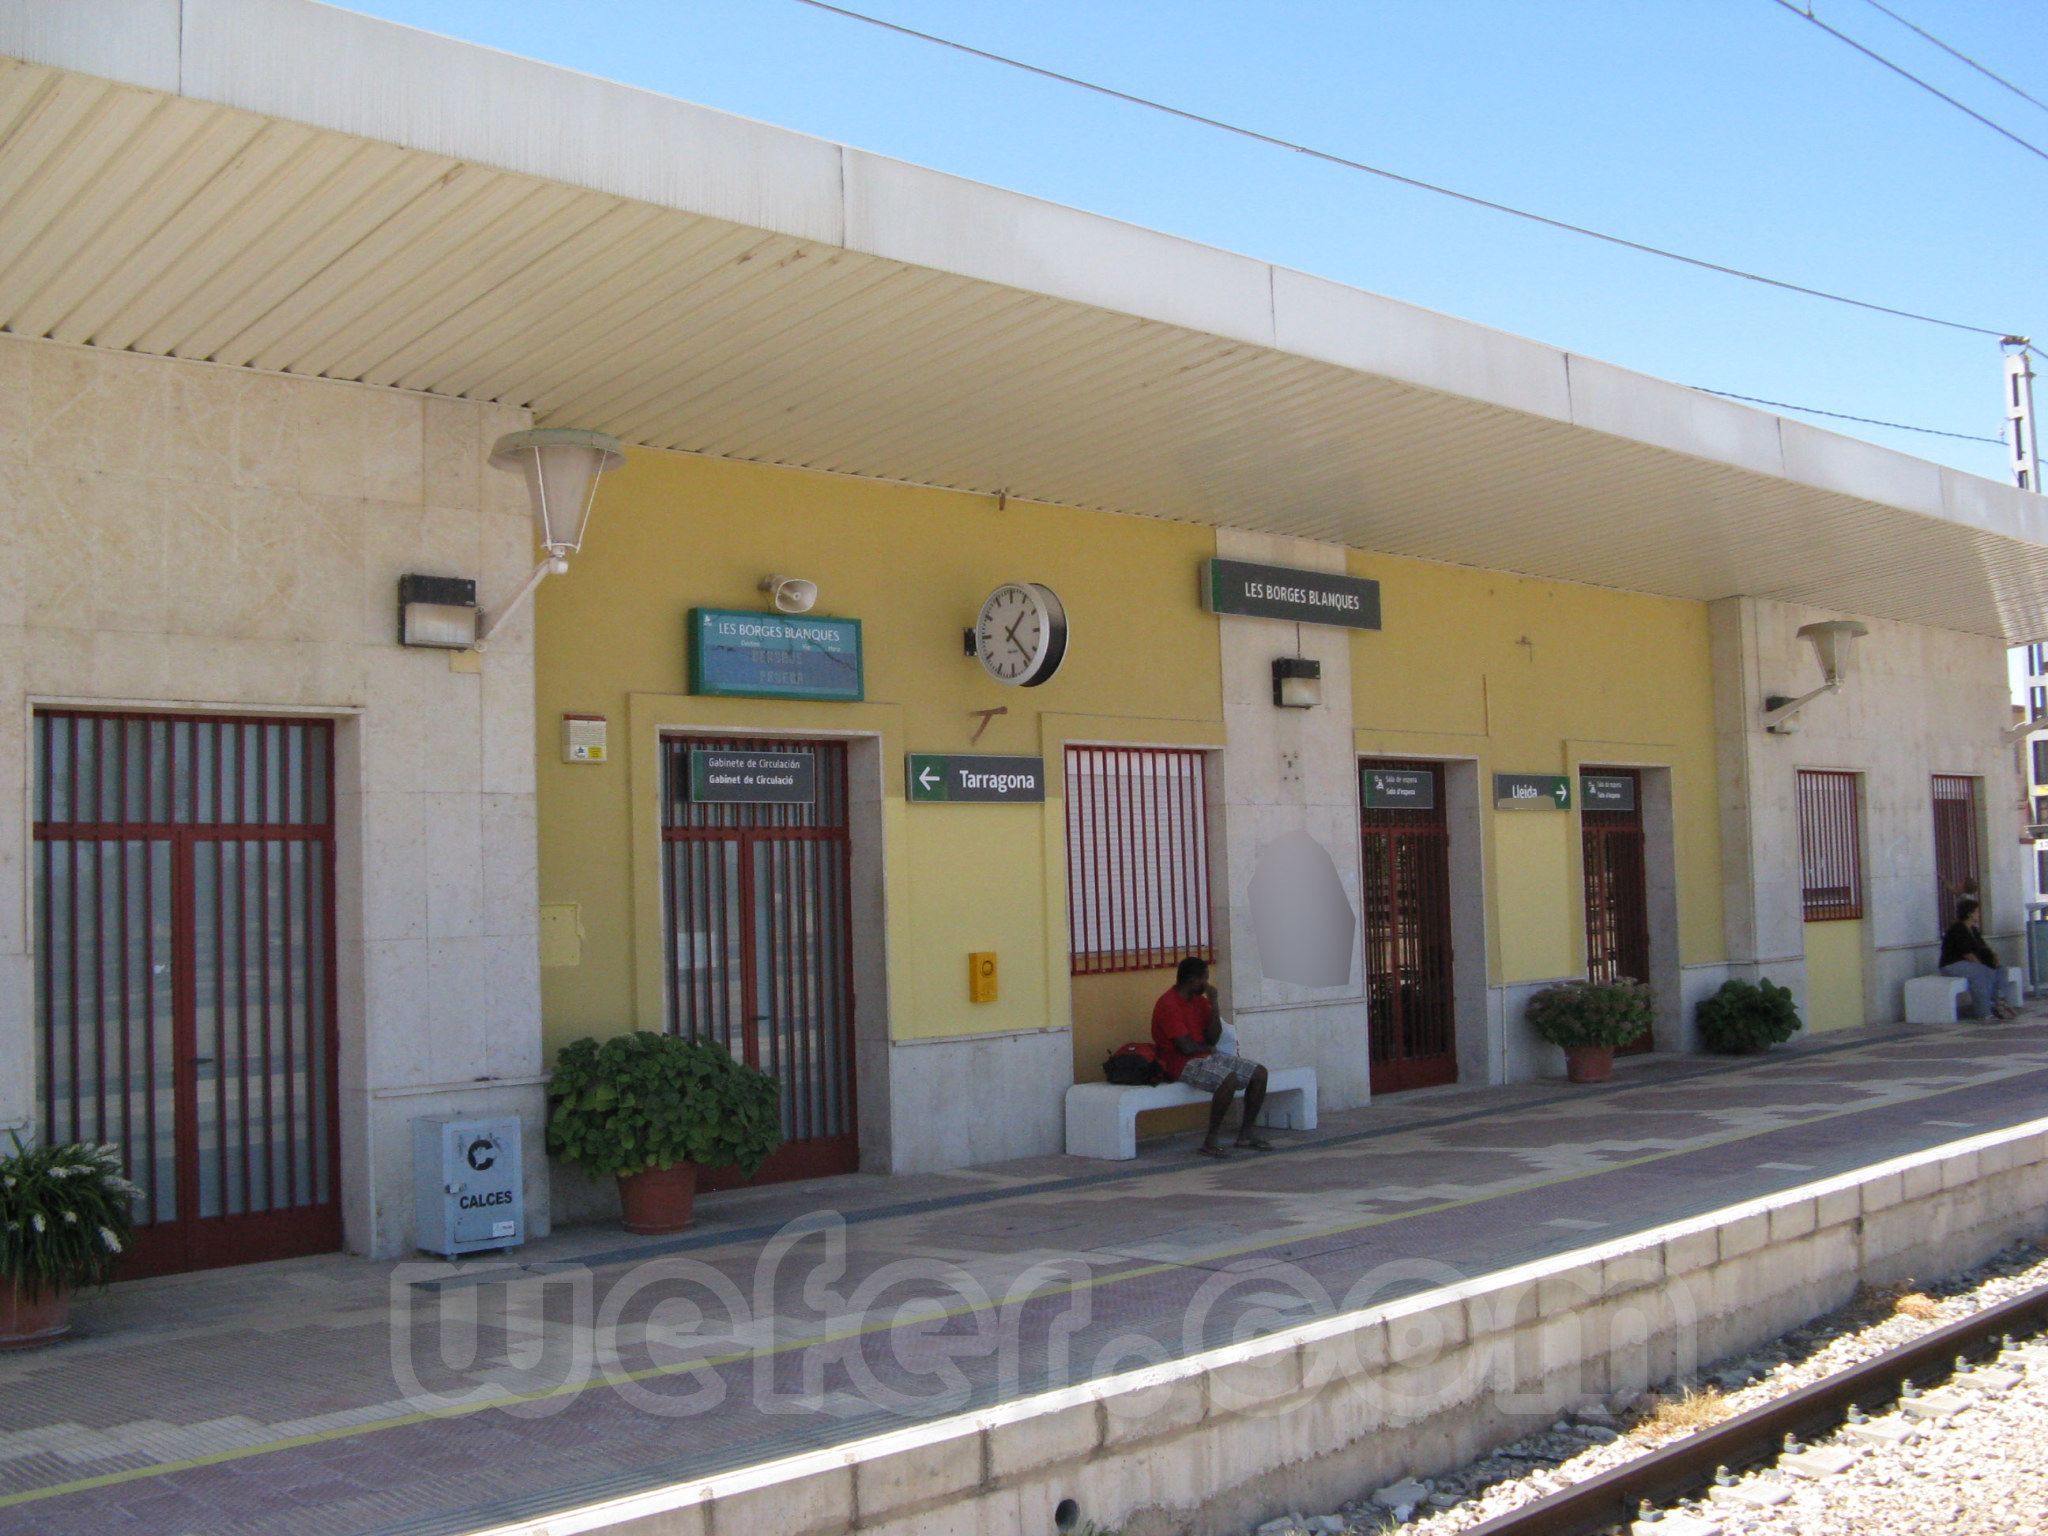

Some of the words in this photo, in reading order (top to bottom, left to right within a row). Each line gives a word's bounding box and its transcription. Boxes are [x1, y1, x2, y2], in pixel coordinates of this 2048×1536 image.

[1245, 581, 1263, 598] LES
[1266, 585, 1306, 604] BORGES
[1308, 590, 1360, 611] BLANQUES
[718, 622, 736, 635] LES
[739, 624, 783, 639] BORGES
[784, 627, 840, 642] BLANQUES
[708, 757, 744, 768] Gabinete
[746, 758, 757, 768] de
[759, 758, 800, 769] Circulación
[708, 774, 741, 784] Gabinet
[743, 775, 754, 784] de
[756, 775, 794, 785] Circulació
[959, 769, 1035, 793] Tarragona
[1512, 784, 1538, 799] Lleida
[459, 1190, 513, 1210] CALCES
